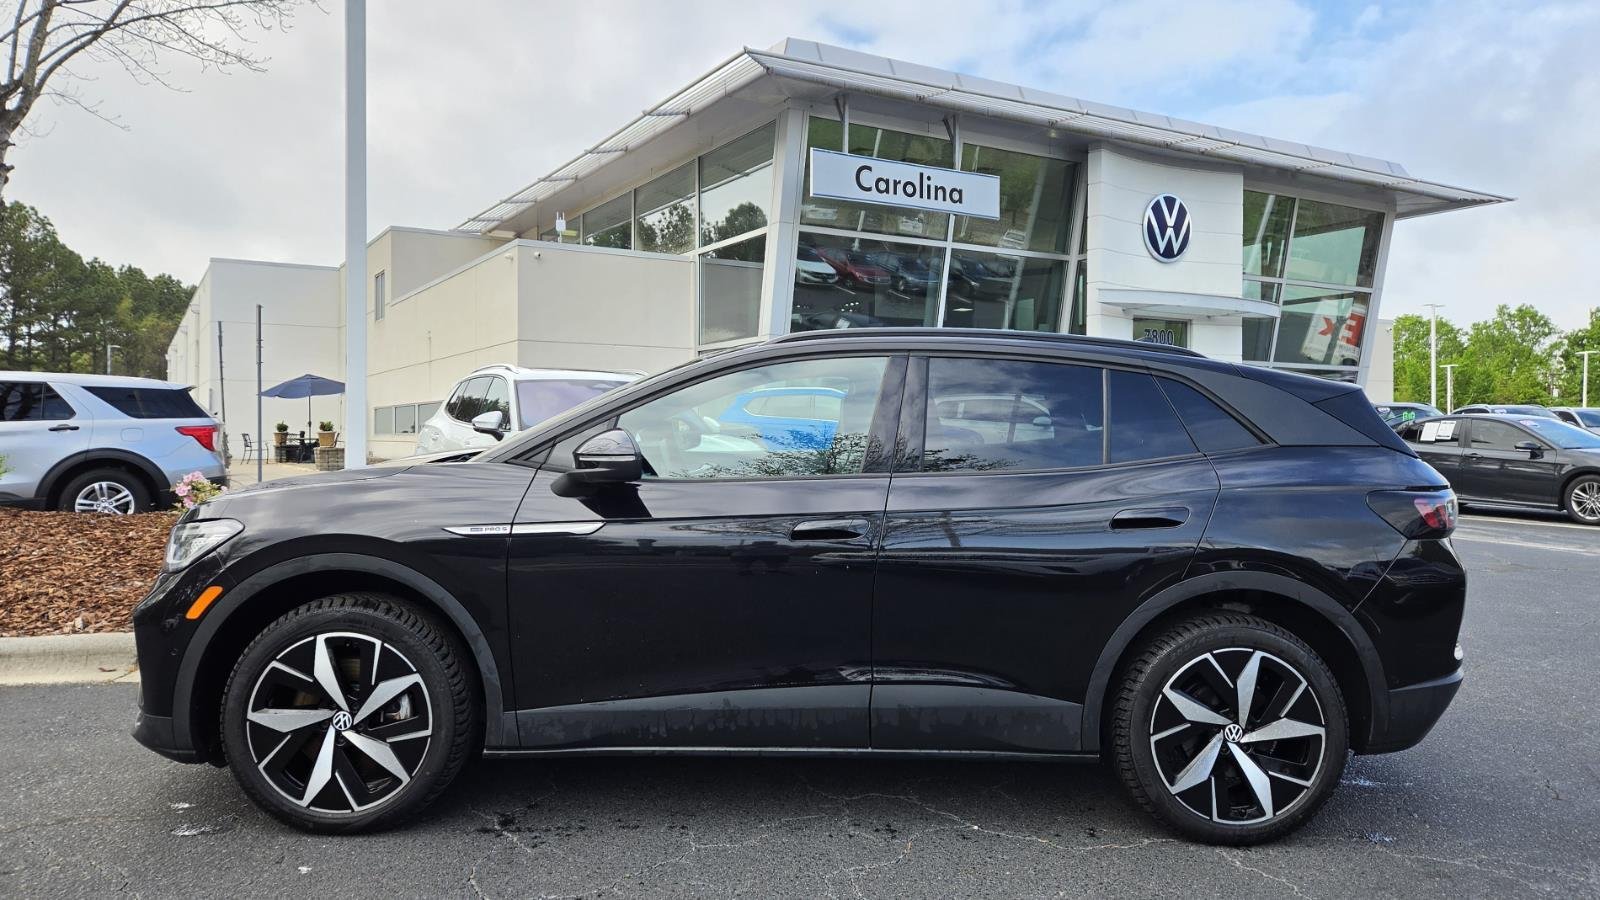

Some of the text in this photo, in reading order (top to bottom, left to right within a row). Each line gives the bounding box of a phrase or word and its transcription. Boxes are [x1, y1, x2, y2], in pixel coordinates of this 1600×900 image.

[855, 164, 963, 205] Carolina
[1143, 193, 1192, 262] VW
[1144, 328, 1174, 346] 7800
